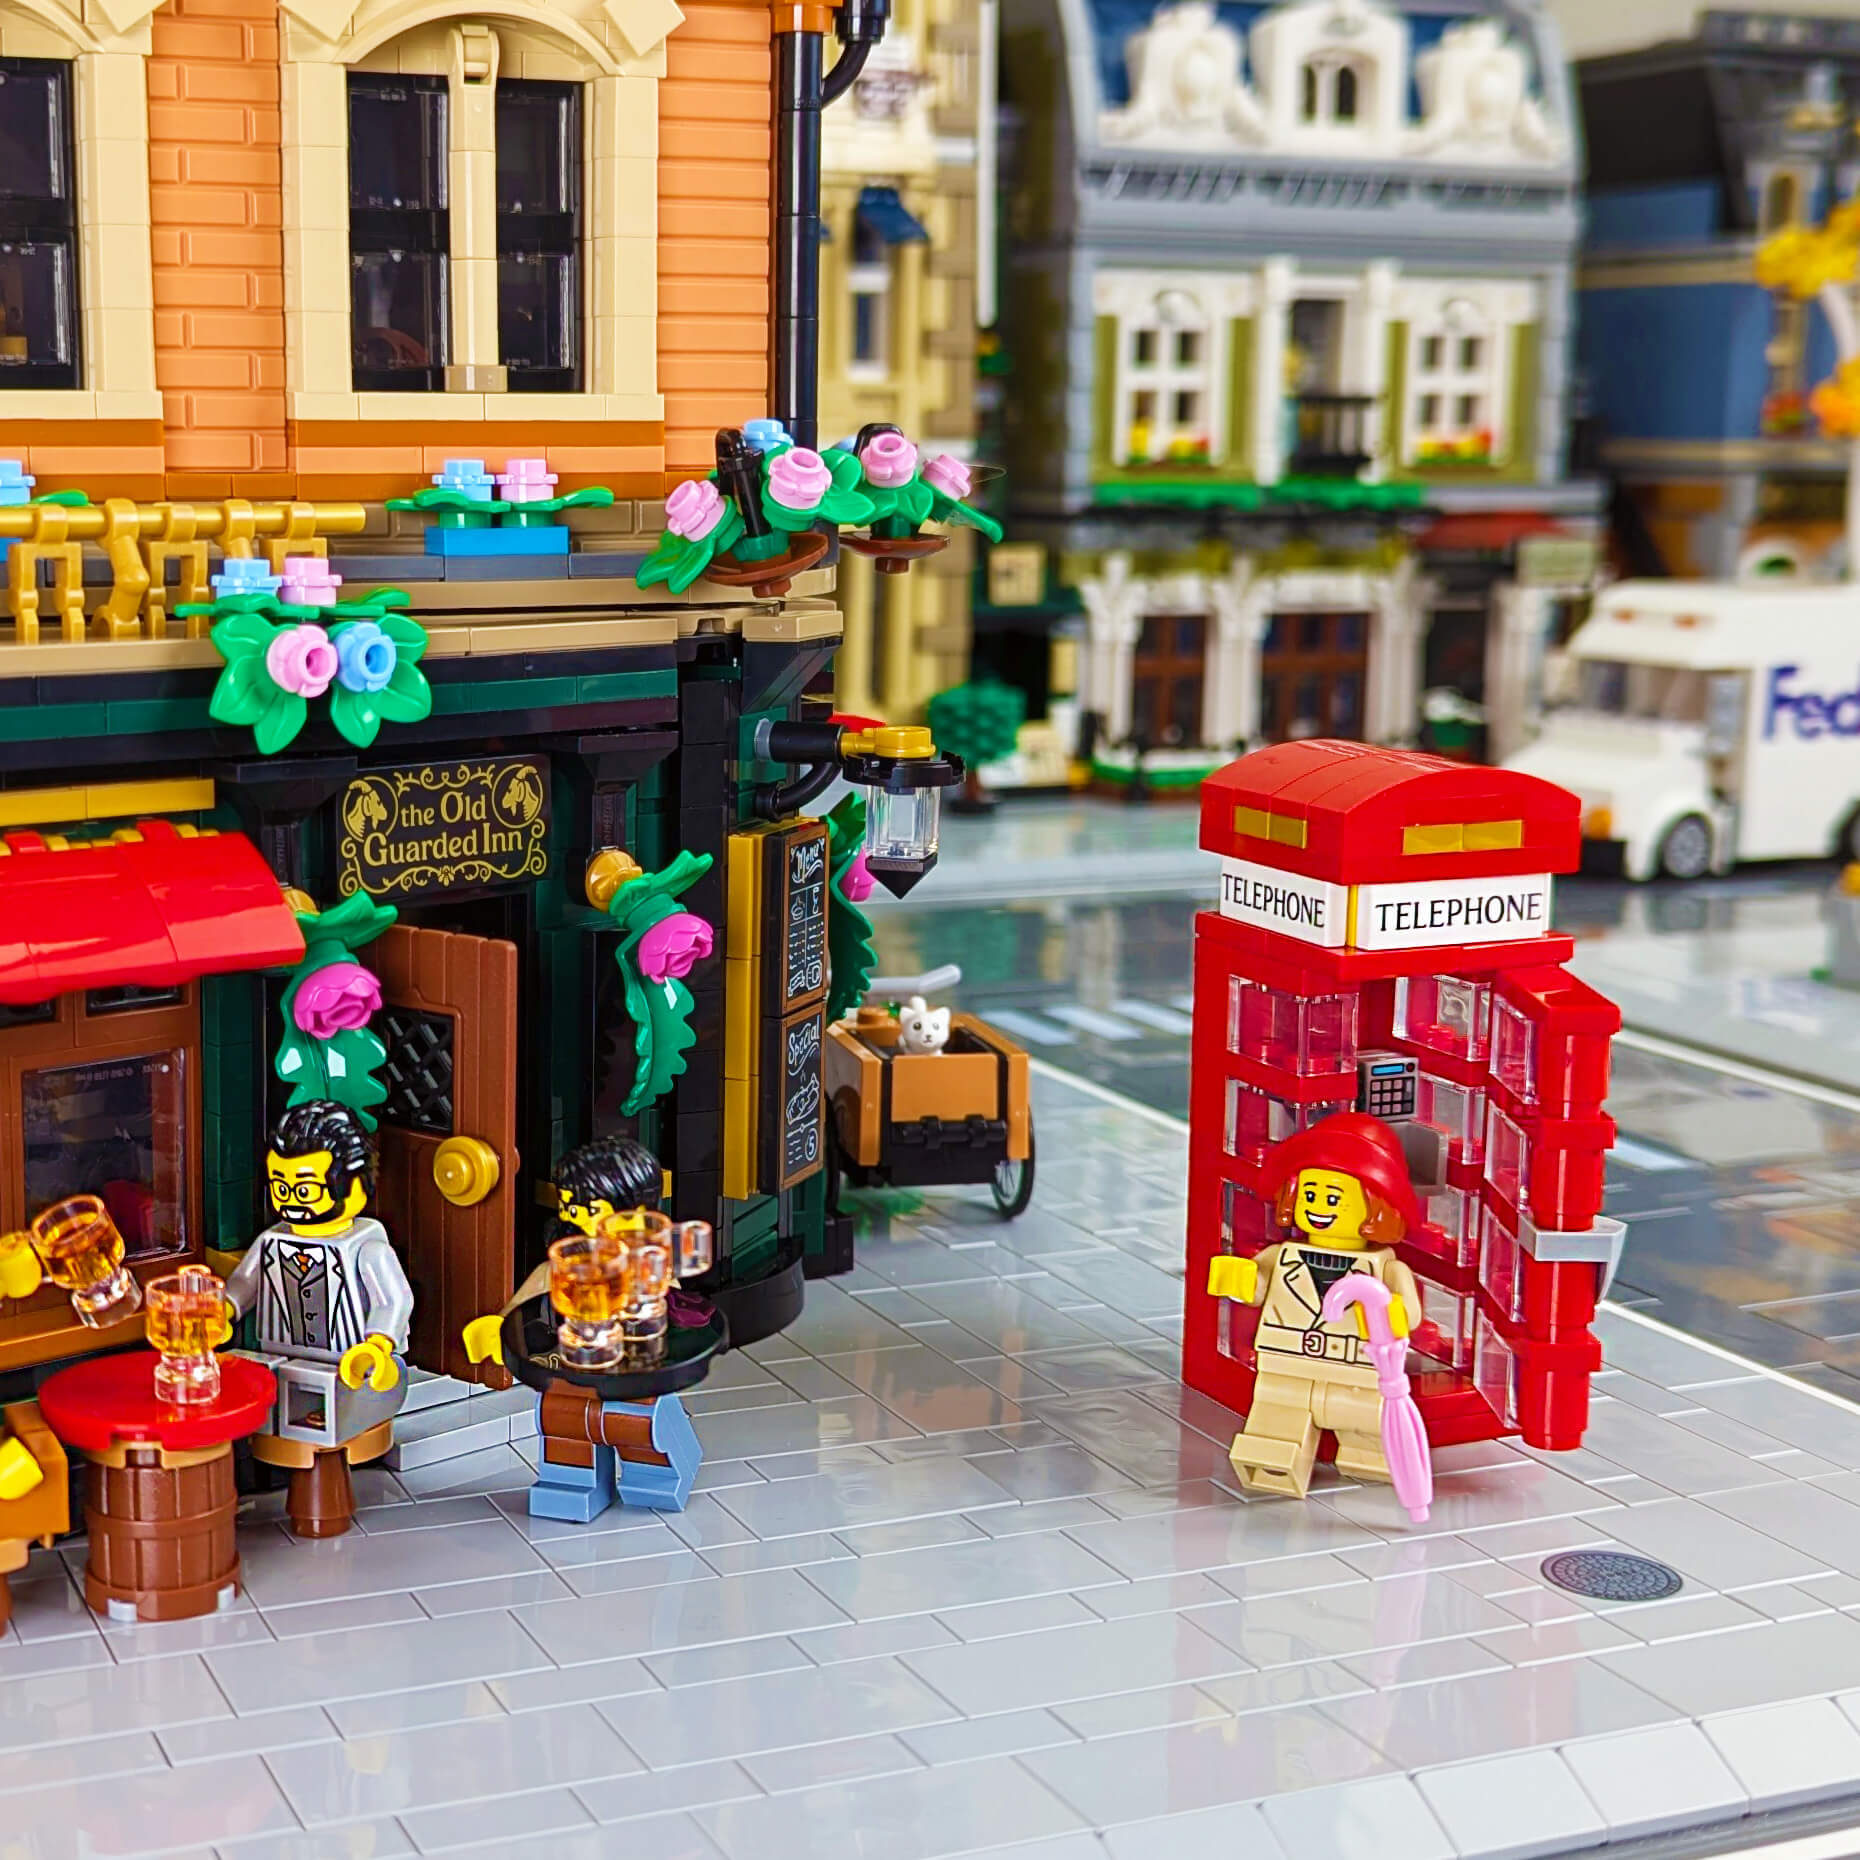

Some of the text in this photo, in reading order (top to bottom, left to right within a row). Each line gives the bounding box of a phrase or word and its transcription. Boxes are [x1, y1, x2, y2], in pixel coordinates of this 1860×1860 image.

[401, 791, 487, 827] the Old
[363, 822, 523, 866] Guarded Inn
[1222, 873, 1325, 927] TELEPHONE
[1375, 892, 1543, 932] TELEPHONE
[788, 1014, 820, 1066] Special
[808, 1135, 815, 1156] 5
